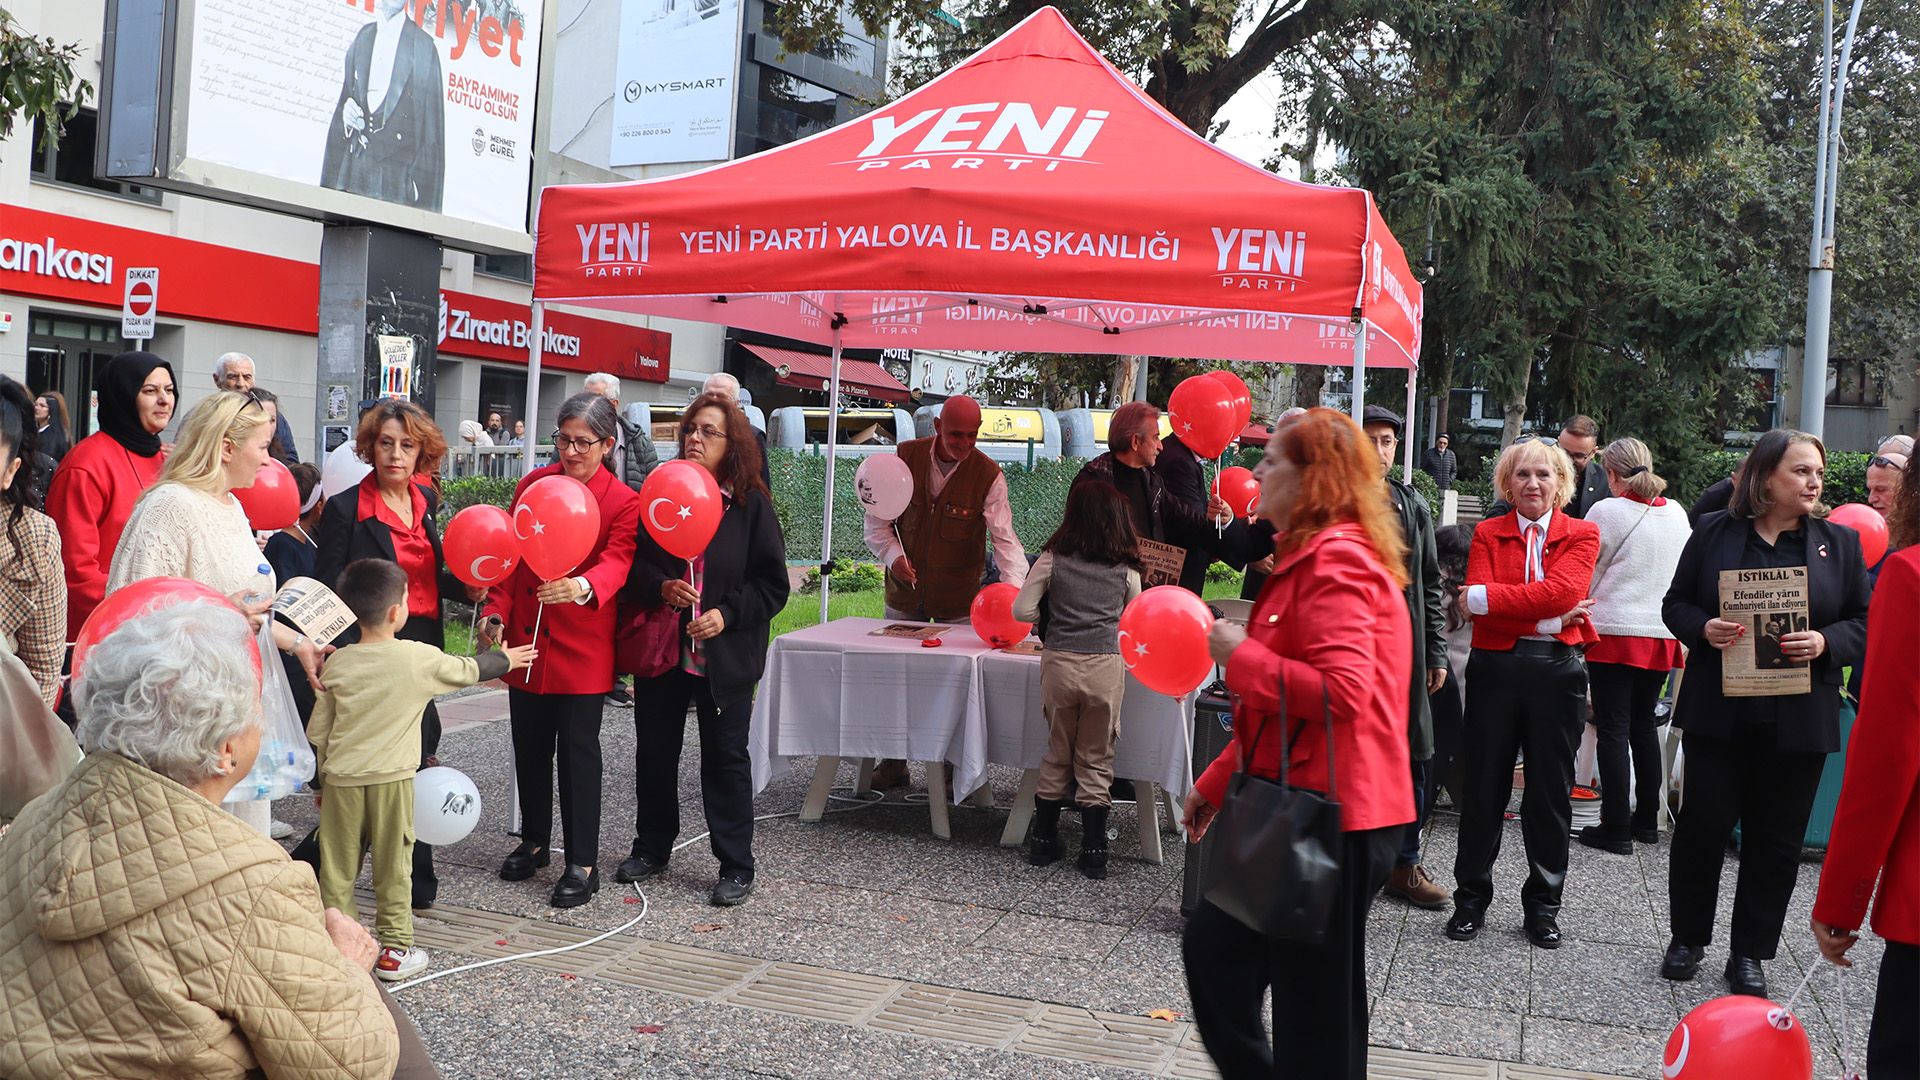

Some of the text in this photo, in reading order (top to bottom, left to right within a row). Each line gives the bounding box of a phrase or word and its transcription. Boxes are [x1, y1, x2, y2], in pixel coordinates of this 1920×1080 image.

[449, 72, 519, 108] BAYRAMIMIZ
[645, 78, 726, 93] MYSMART
[447, 89, 518, 122] KUTLU OLSUN
[490, 134, 516, 148] MEHMET
[680, 220, 1180, 262] YENİ PARTİ YALOVA İL BAŞKANLIĞI
[142, 318, 152, 326] VAR
[449, 309, 511, 346] Ziraat
[389, 353, 408, 365] ROLLER
[884, 348, 911, 361] HOTEL
[639, 356, 659, 368] Yalova
[1734, 590, 1774, 600] Efendiler
[1723, 600, 1807, 611] Cumhuriyeti ilan ediyoruz
